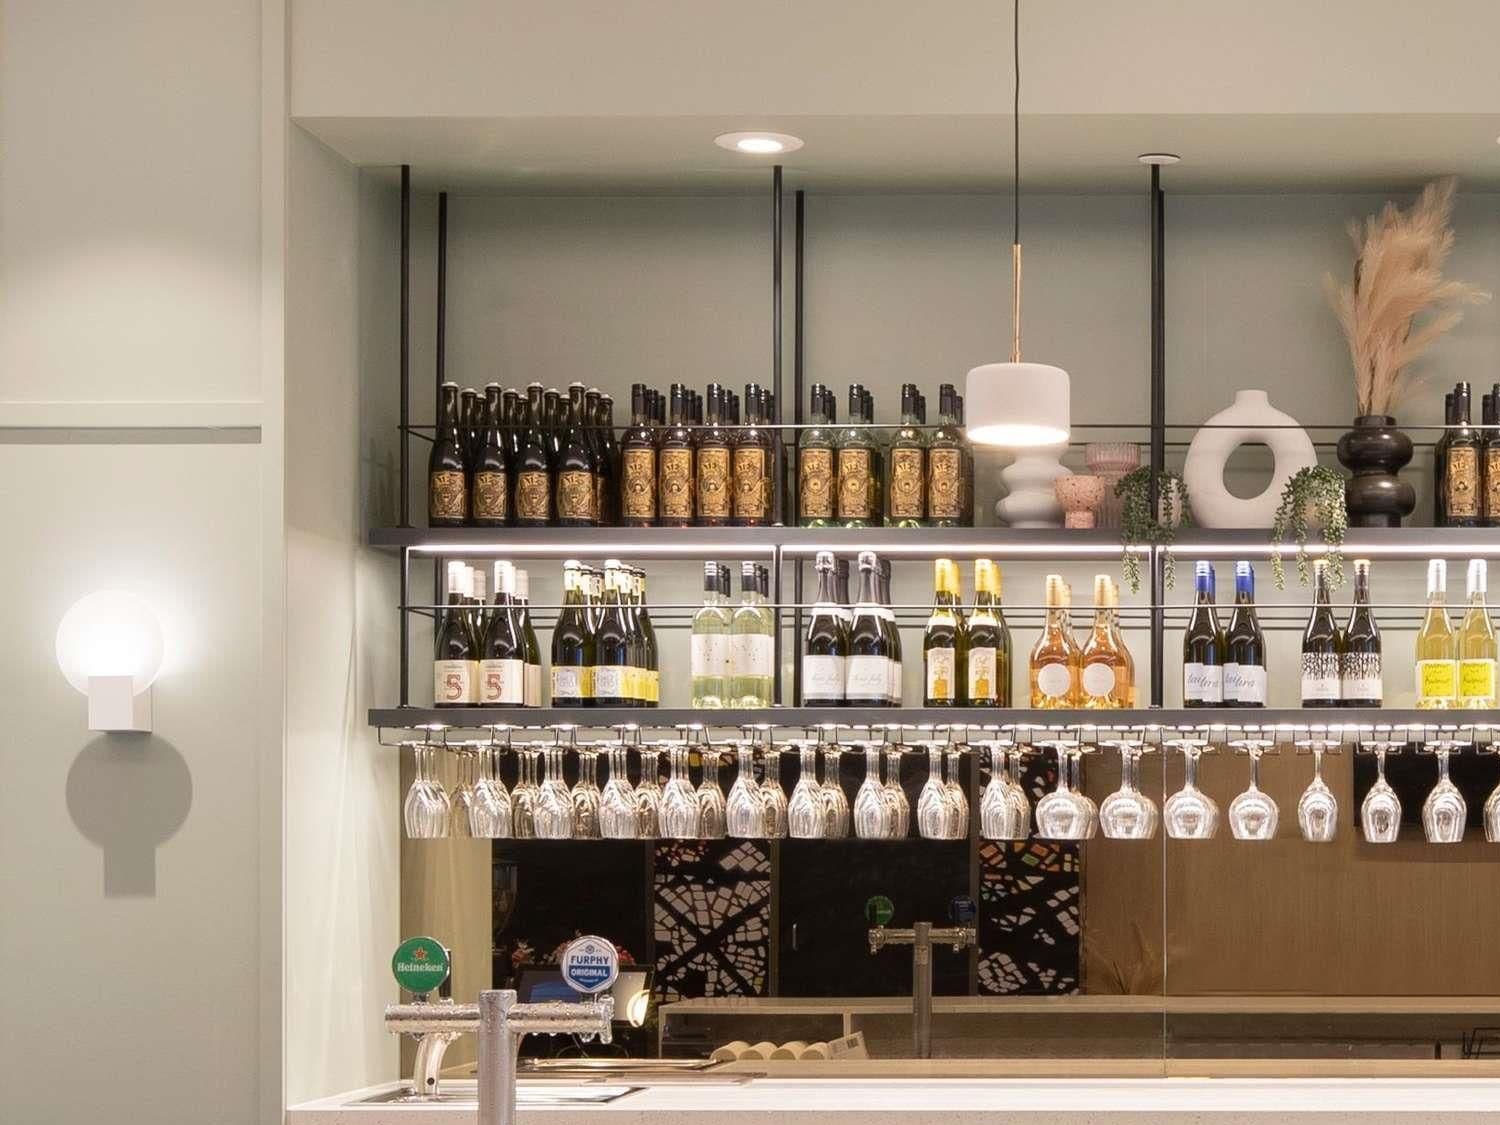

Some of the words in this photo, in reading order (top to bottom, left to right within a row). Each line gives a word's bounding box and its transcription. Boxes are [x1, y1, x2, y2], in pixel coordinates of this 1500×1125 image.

[446, 673, 463, 700] 5
[486, 673, 502, 700] 5
[570, 955, 609, 965] FURPHY
[397, 962, 443, 972] Heineken
[570, 968, 608, 977] ORIGINAL
